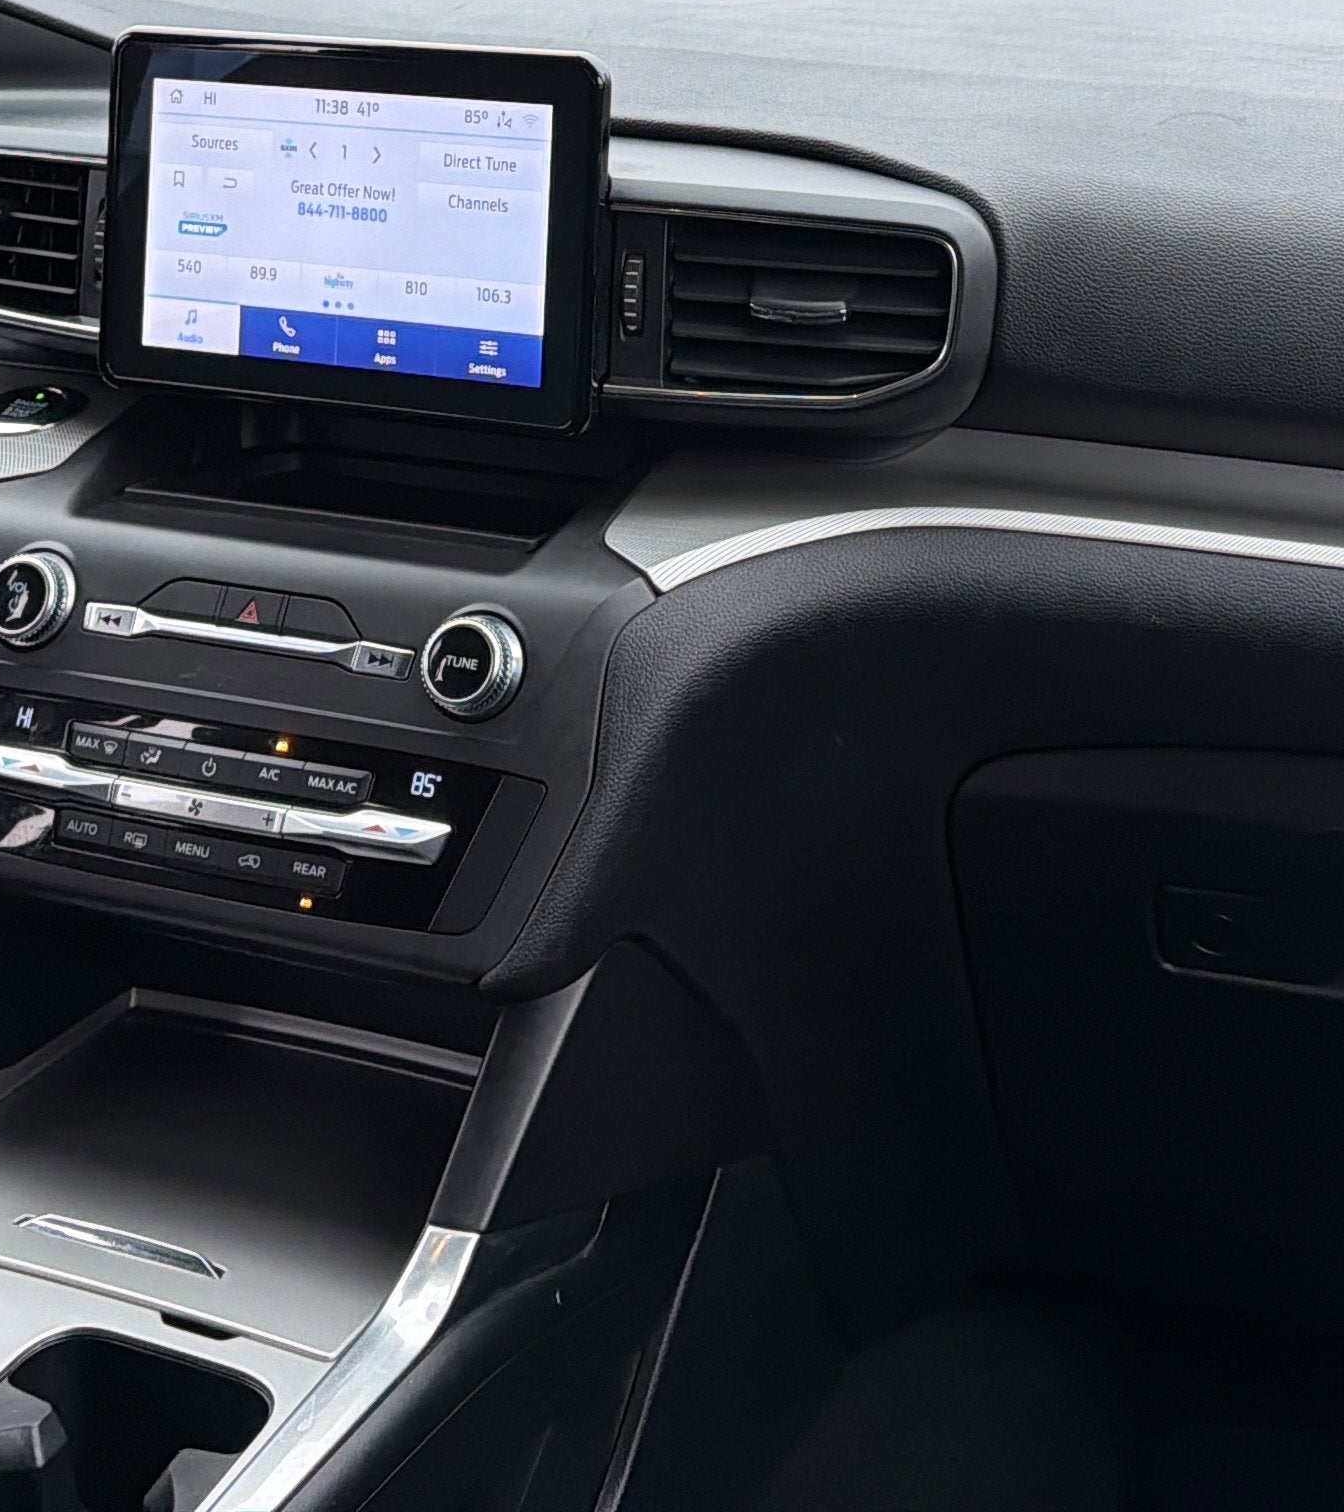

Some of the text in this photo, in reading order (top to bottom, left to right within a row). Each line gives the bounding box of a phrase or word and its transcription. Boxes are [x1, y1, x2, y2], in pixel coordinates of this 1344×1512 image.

[203, 92, 217, 106] HI
[315, 98, 349, 116] 11:38
[191, 134, 239, 152] Sources
[342, 144, 347, 160] 1
[443, 153, 517, 173] Direct Tune
[290, 180, 396, 202] Great Offer Now!
[448, 194, 509, 213] Channels
[297, 202, 388, 223] 844-711-8800
[177, 259, 202, 274] 540
[250, 266, 277, 281] 89.9
[405, 280, 428, 296] 810
[476, 287, 512, 304] 106.3
[177, 332, 203, 344] Audio
[272, 341, 300, 355] Phone
[374, 352, 397, 366] Apps
[468, 362, 507, 379] Settings
[7, 580, 29, 594] VOL
[445, 654, 480, 671] TUNE
[15, 705, 35, 729] HI
[75, 735, 101, 750] MAX
[259, 766, 281, 783] A/C
[308, 775, 358, 795] MAX A/C
[66, 819, 98, 836] AUTO
[175, 841, 210, 859] MENU
[292, 861, 327, 879] REAR
